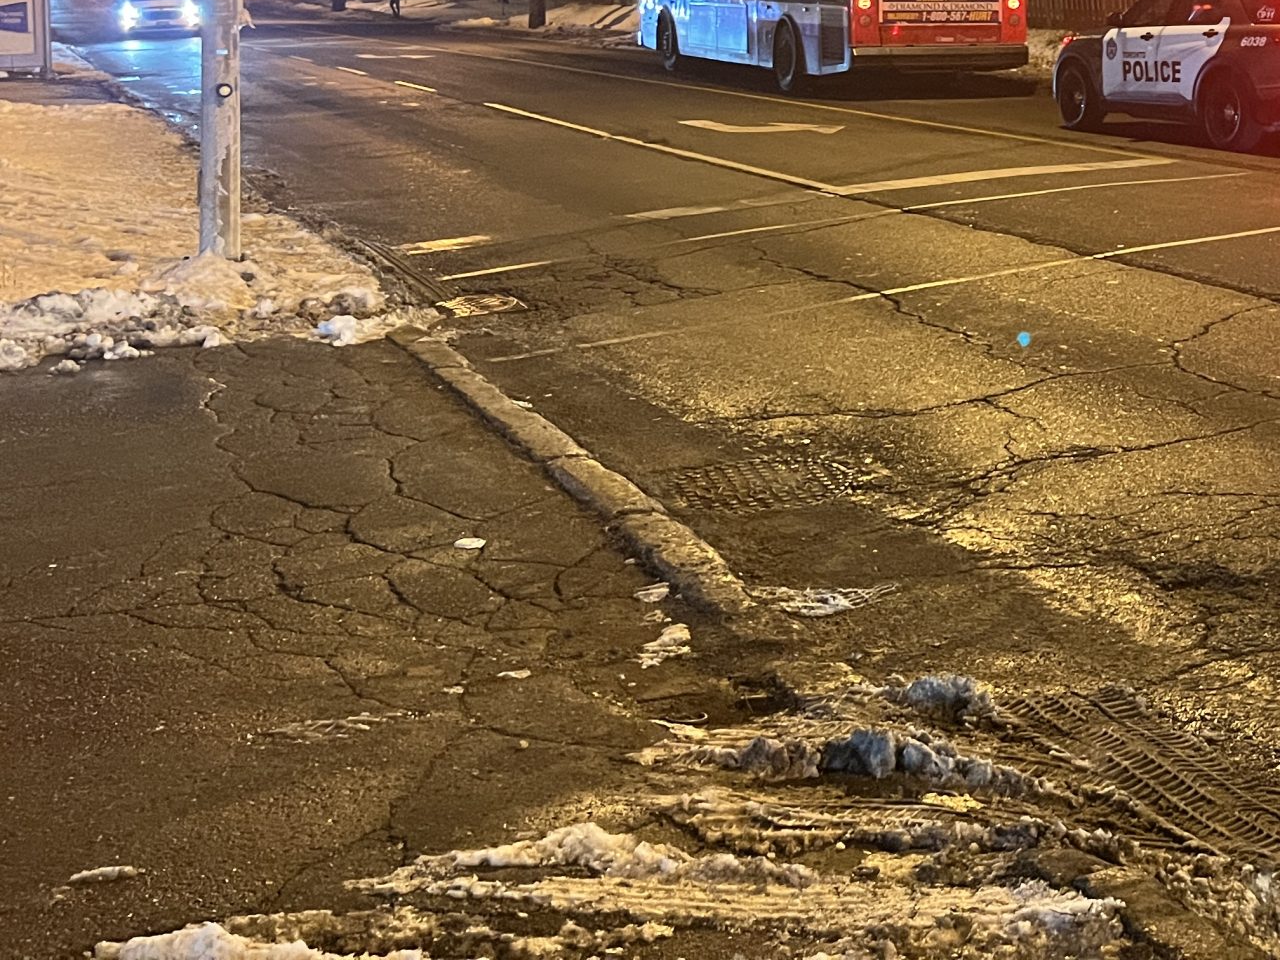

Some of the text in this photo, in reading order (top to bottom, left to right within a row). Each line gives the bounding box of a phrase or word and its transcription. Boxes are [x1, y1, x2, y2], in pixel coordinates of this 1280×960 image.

[896, 3, 941, 11] DIAMOND
[950, 3, 993, 11] DIAMOND
[1241, 36, 1267, 47] 6038
[1122, 60, 1182, 83] POLICE
